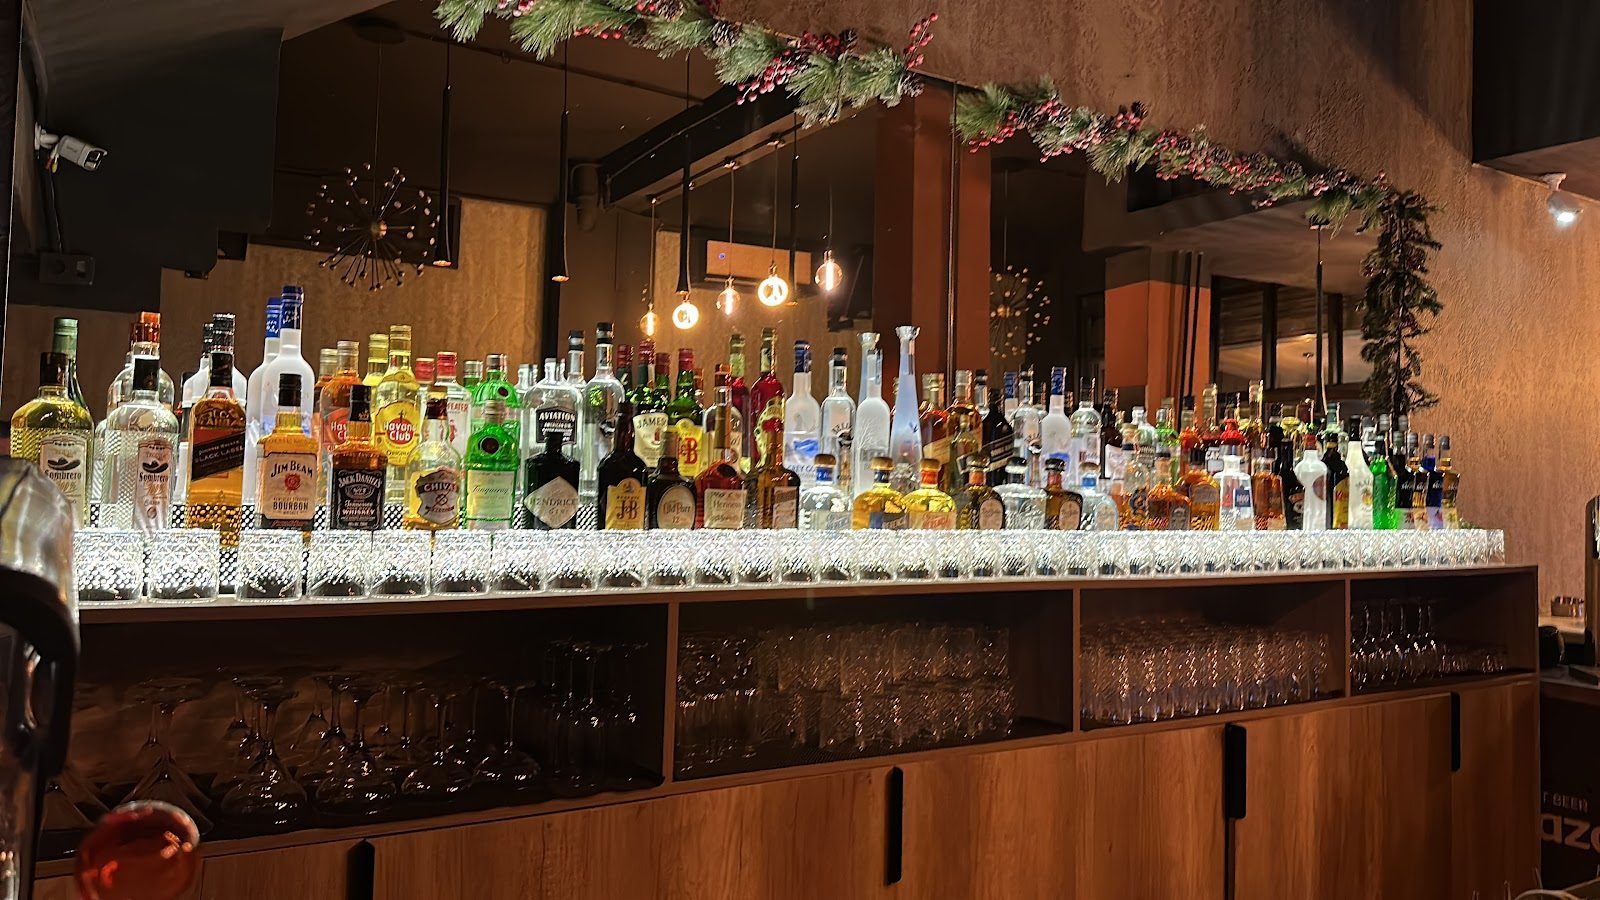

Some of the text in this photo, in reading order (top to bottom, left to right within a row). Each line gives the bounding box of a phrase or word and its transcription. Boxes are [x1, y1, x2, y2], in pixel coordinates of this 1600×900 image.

[539, 411, 576, 422] AVIATION
[331, 421, 347, 431] Hav
[637, 416, 667, 429] JAMES
[338, 430, 346, 440] Cl
[389, 430, 411, 441] Club
[194, 451, 220, 464] BLACK
[271, 460, 313, 478] JIM BEAM
[139, 472, 169, 482] Sombrero
[338, 474, 356, 488] JACK
[473, 485, 509, 495] Tanqueray
[273, 501, 309, 510] BOURBON
